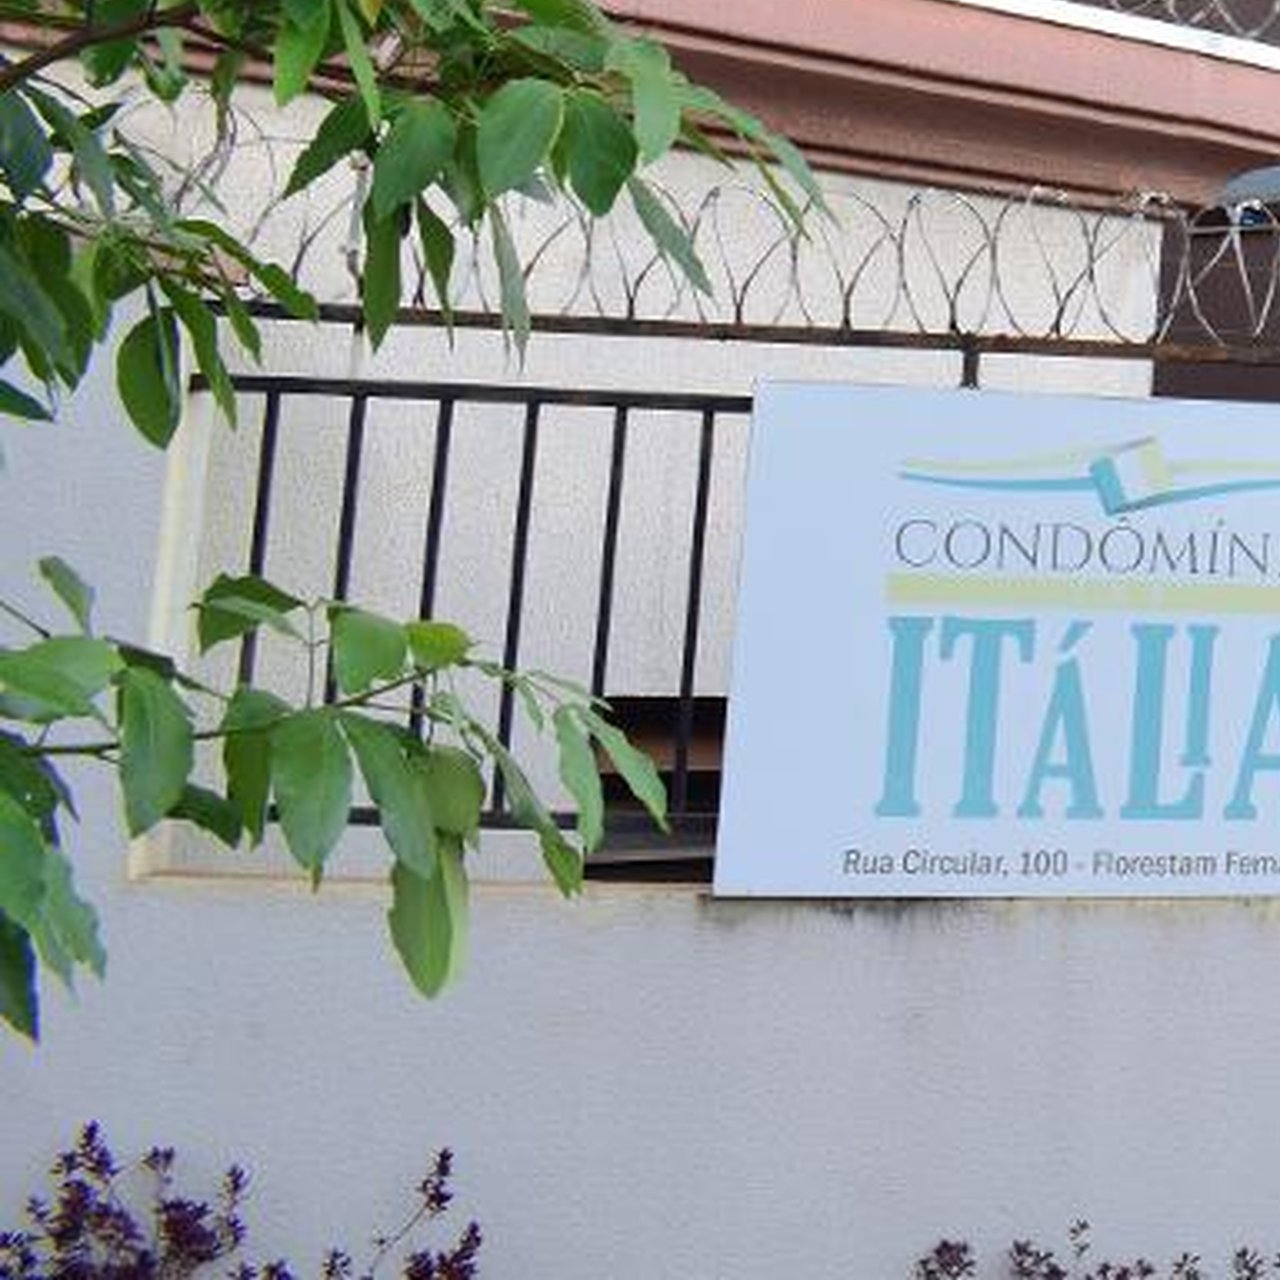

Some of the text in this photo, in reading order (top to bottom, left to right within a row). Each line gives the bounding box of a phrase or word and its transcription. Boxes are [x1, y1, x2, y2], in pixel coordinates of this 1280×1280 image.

[843, 848, 893, 875] Rua
[902, 848, 1008, 877] Circular,
[1021, 849, 1068, 876] 100
